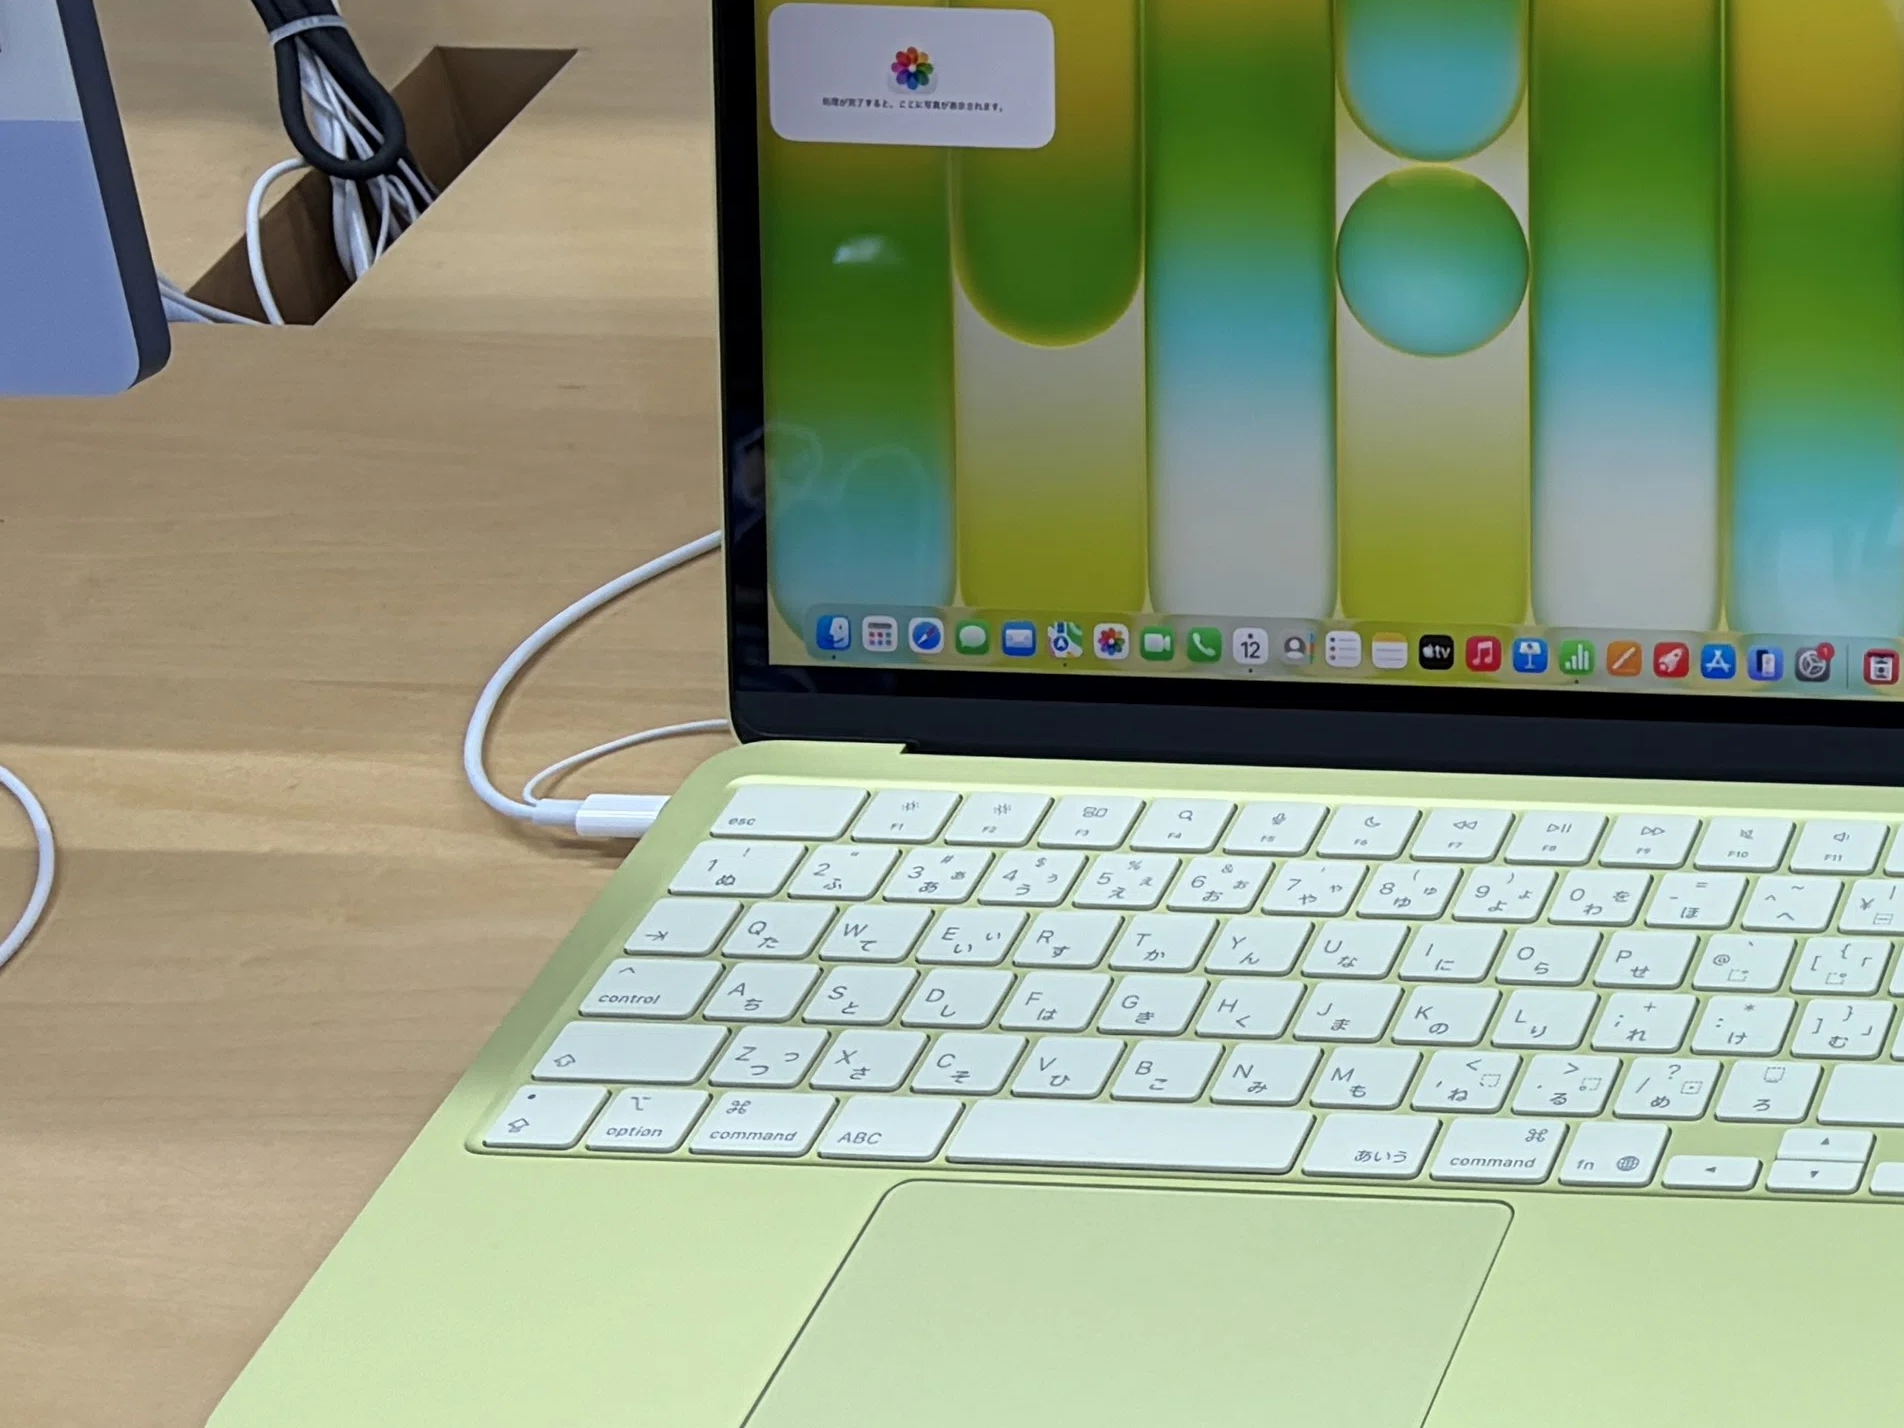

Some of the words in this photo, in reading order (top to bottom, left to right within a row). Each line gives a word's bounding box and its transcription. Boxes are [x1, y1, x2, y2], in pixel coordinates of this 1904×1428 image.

[1239, 640, 1262, 659] 12
[727, 816, 756, 827] esc
[748, 921, 765, 940] Q
[598, 991, 660, 1006] control
[605, 1124, 663, 1139] option
[709, 1128, 797, 1143] command
[836, 1131, 882, 1145] ABC
[1354, 1149, 1408, 1164] あいう
[1449, 1156, 1536, 1170] command
[1576, 1159, 1595, 1171] fn
